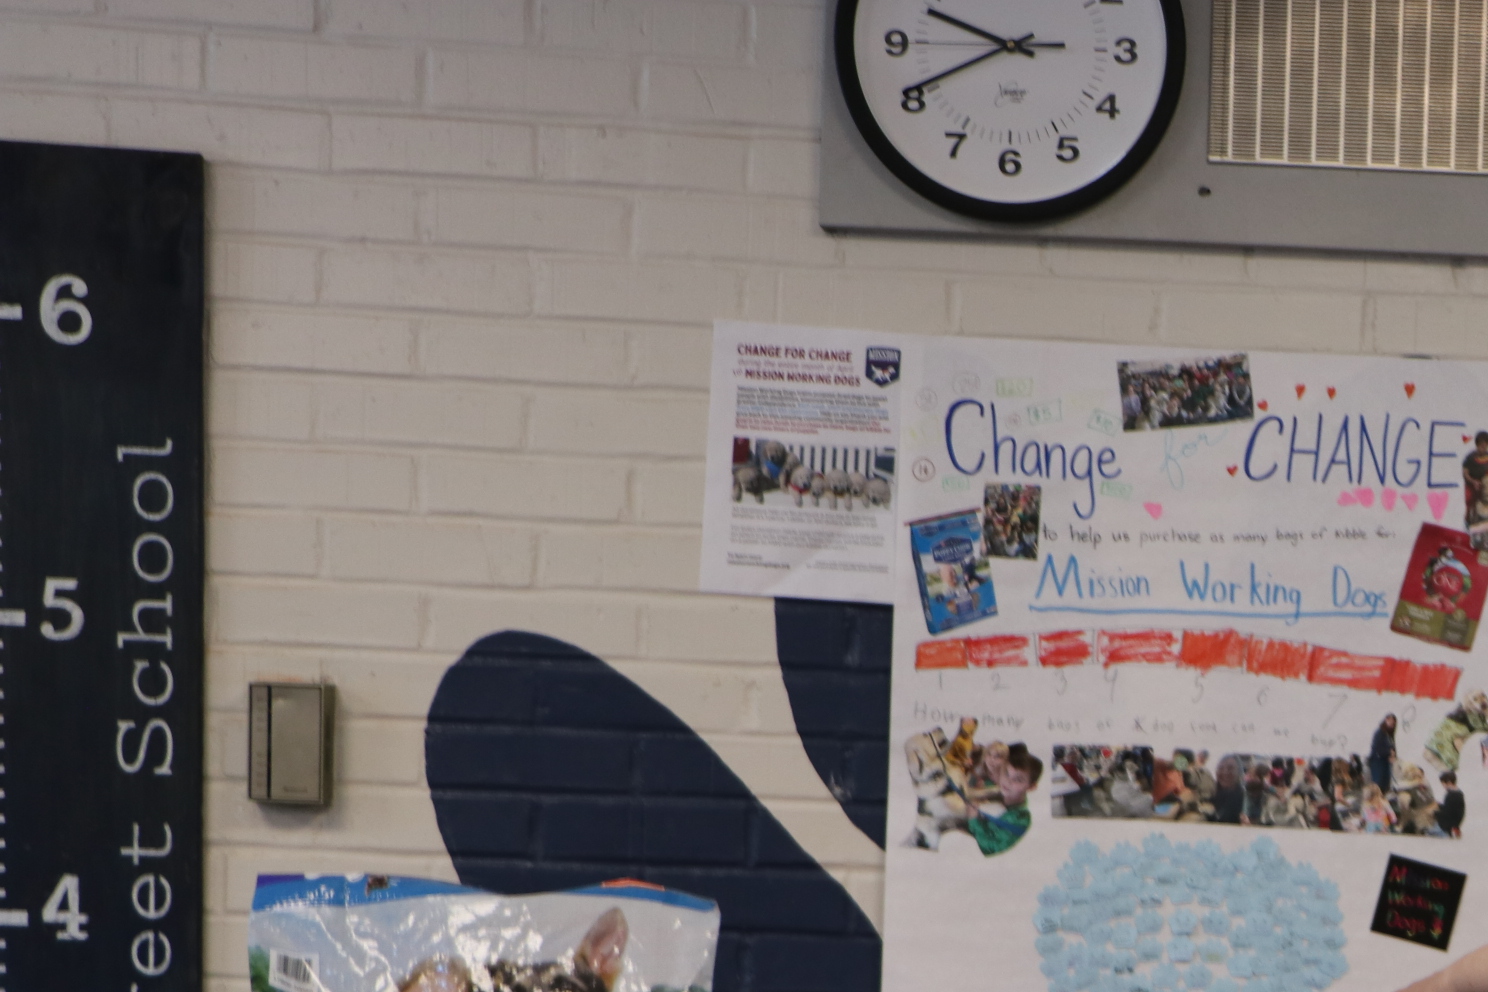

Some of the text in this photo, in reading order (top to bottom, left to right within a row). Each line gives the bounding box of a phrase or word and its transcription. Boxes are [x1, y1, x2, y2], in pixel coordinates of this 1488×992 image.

[885, 30, 909, 57] 9
[1113, 38, 1138, 65] 3
[901, 85, 926, 113] 8
[1095, 94, 1120, 120] 4
[945, 131, 967, 159] 7
[1056, 136, 1080, 162] 5
[998, 150, 1022, 175] 6
[40, 273, 93, 345] 6
[737, 343, 852, 363] CHANGE FOR CHANGE
[745, 368, 861, 388] MISSION WORKING DOGS
[945, 398, 1122, 520] Change
[1244, 412, 1467, 488] CHANGE
[1042, 523, 1058, 542] to
[1069, 525, 1102, 549] help
[1112, 531, 1130, 542] us
[1140, 527, 1201, 547] purchase
[1210, 533, 1226, 542] as
[1233, 531, 1268, 546] many
[1275, 526, 1304, 547] bags
[1035, 553, 1388, 627] Mission Working Dogs
[40, 577, 85, 641] 5
[117, 437, 174, 776] School
[938, 672, 943, 691] 1
[990, 672, 1010, 692] 2
[1054, 671, 1068, 696] 3
[1103, 669, 1119, 703] 4
[1193, 674, 1205, 704] 5
[1326, 691, 1349, 730] 7
[42, 873, 89, 941] 4
